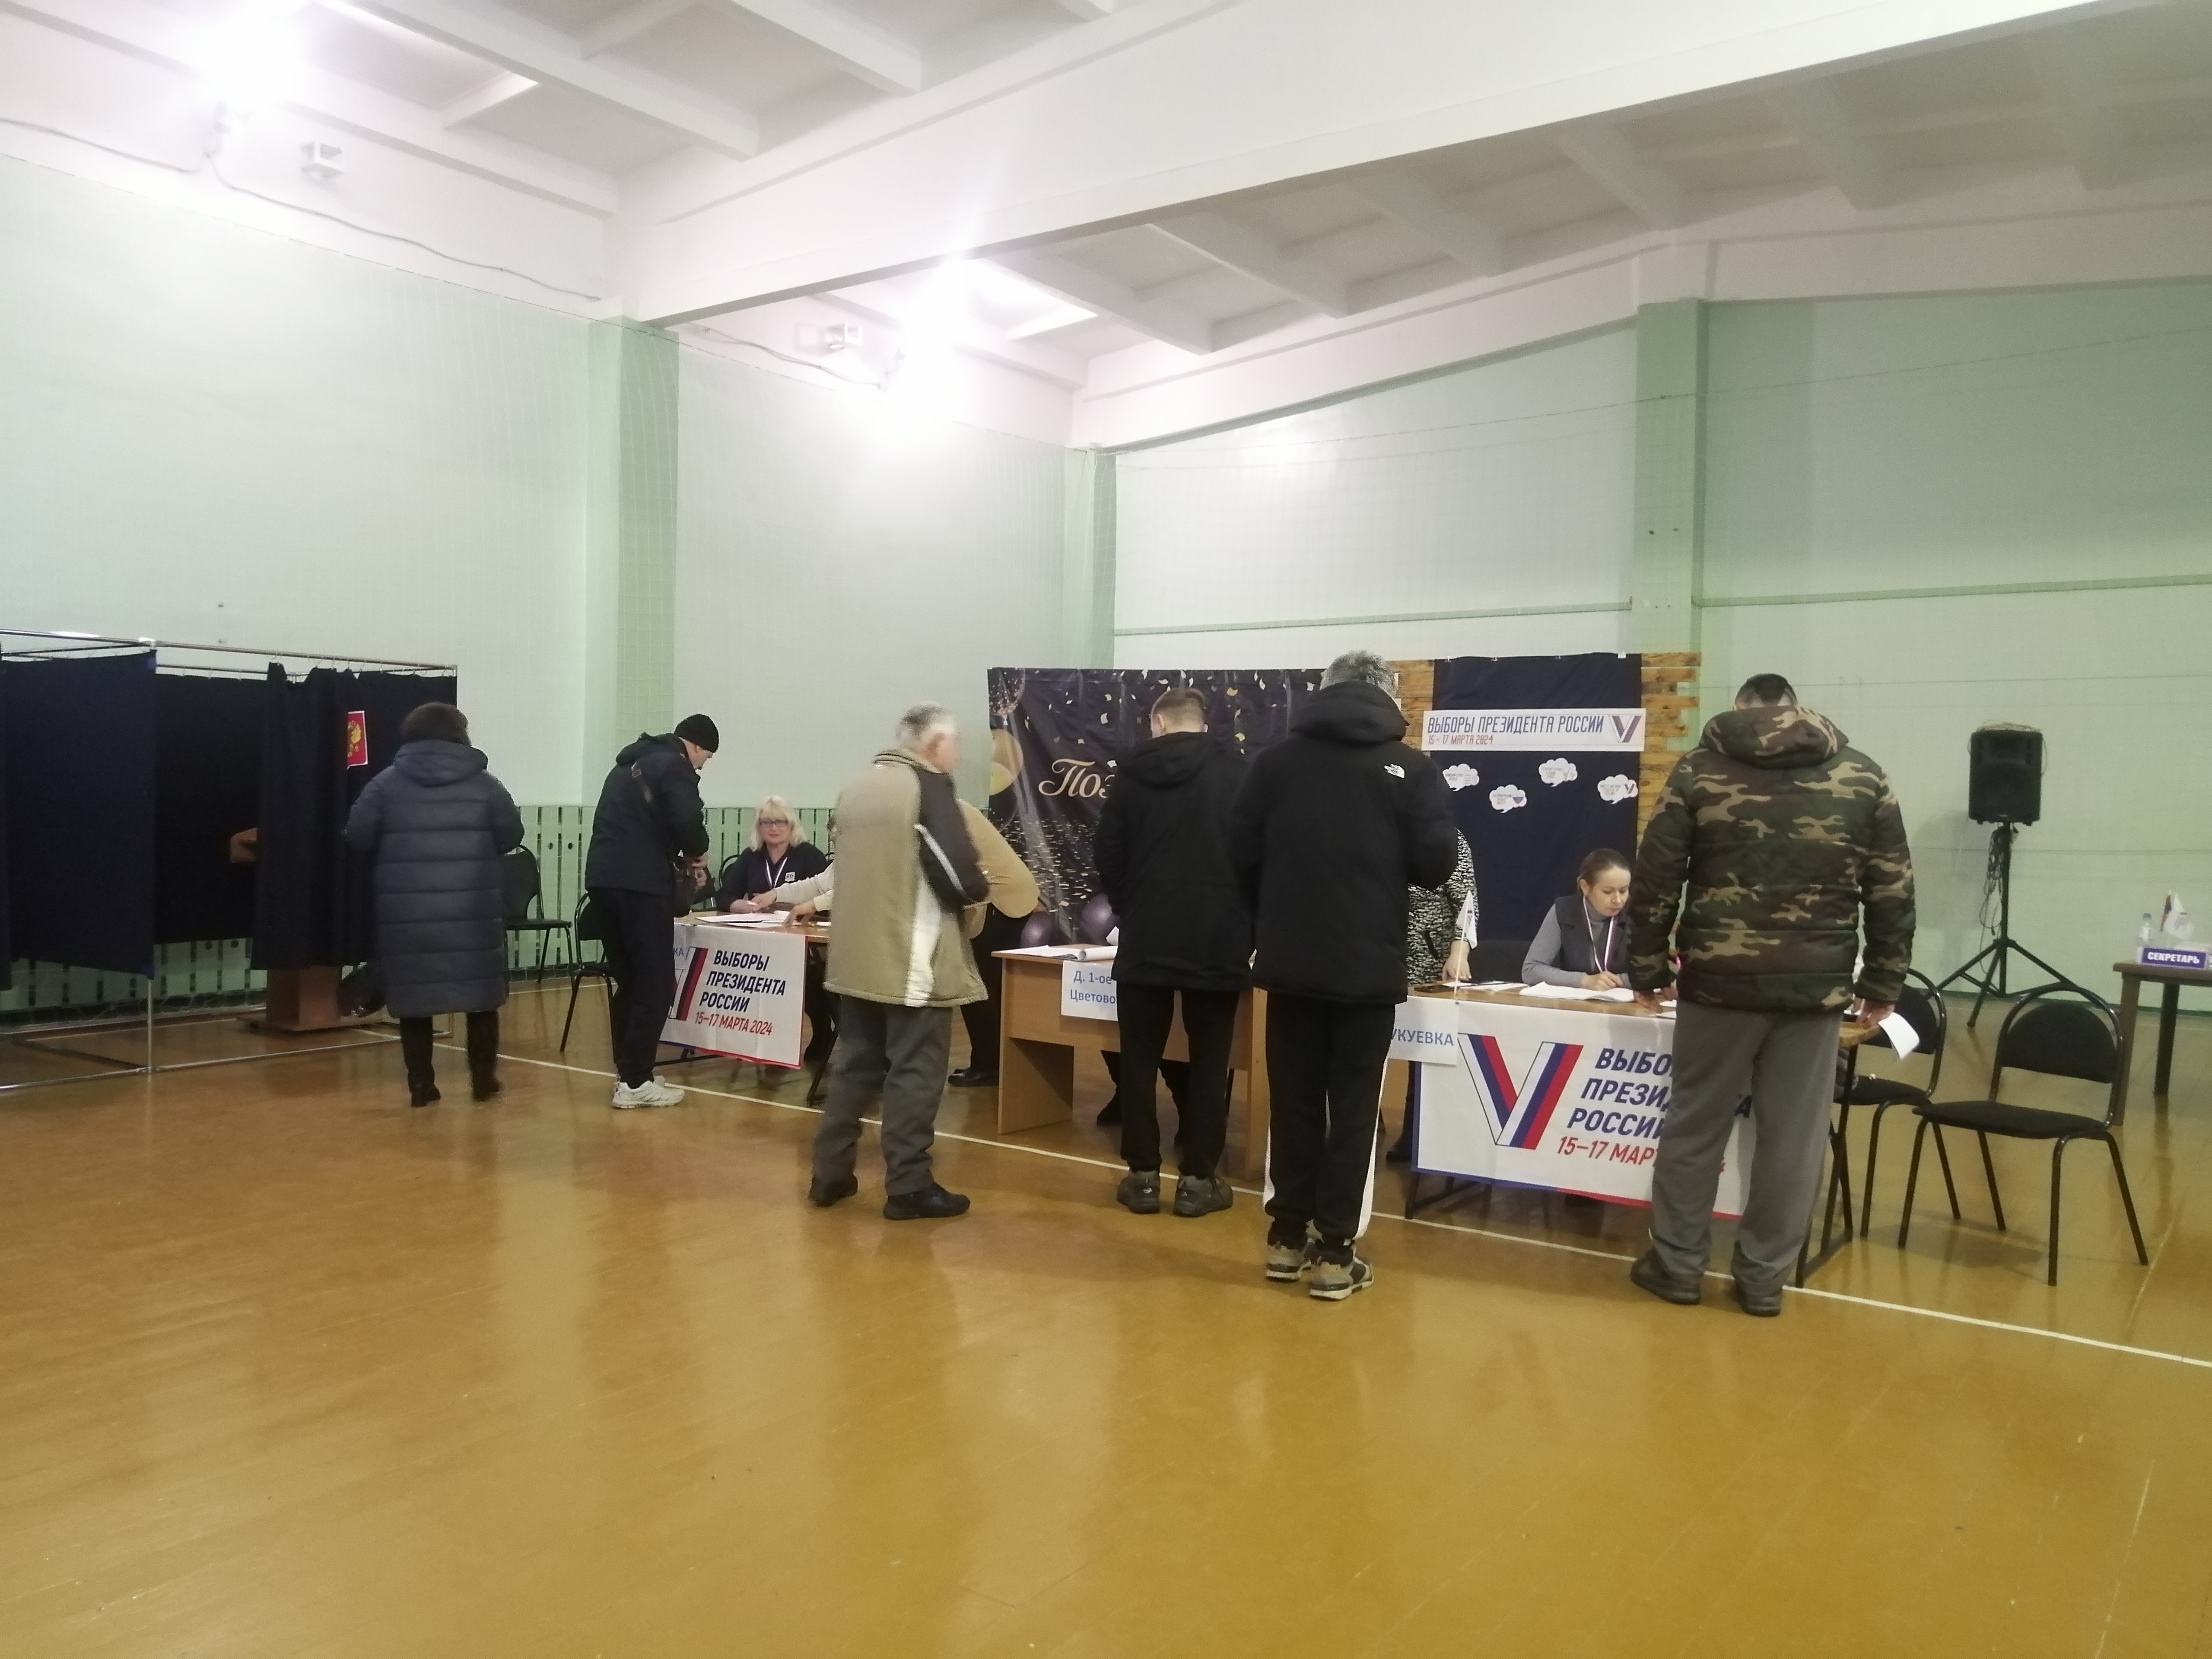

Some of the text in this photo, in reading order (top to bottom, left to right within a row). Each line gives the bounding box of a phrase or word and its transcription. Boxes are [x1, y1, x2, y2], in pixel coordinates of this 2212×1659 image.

[1427, 715, 1604, 734] ВЫБОРЫ ПРЕЗИДЕНТА РОССИИ
[1428, 735, 1434, 744] 15
[1442, 735, 1449, 744] 17
[1450, 735, 1474, 744] МАРТА
[713, 950, 770, 971] ВЫБОРЫ
[2147, 952, 2200, 964] СЕКРЕТАРЬ
[706, 971, 786, 996] ПРЕЗИДЕНТА
[1073, 971, 1112, 985] Д. 1-ое
[699, 992, 750, 1013] РОССИИ
[1070, 989, 1116, 1004] Цветово
[719, 1015, 750, 1032] МАРТА
[750, 1020, 772, 1036] 2024
[1595, 1048, 1672, 1077] ВЫБО
[1609, 1143, 1658, 1165] МАР
